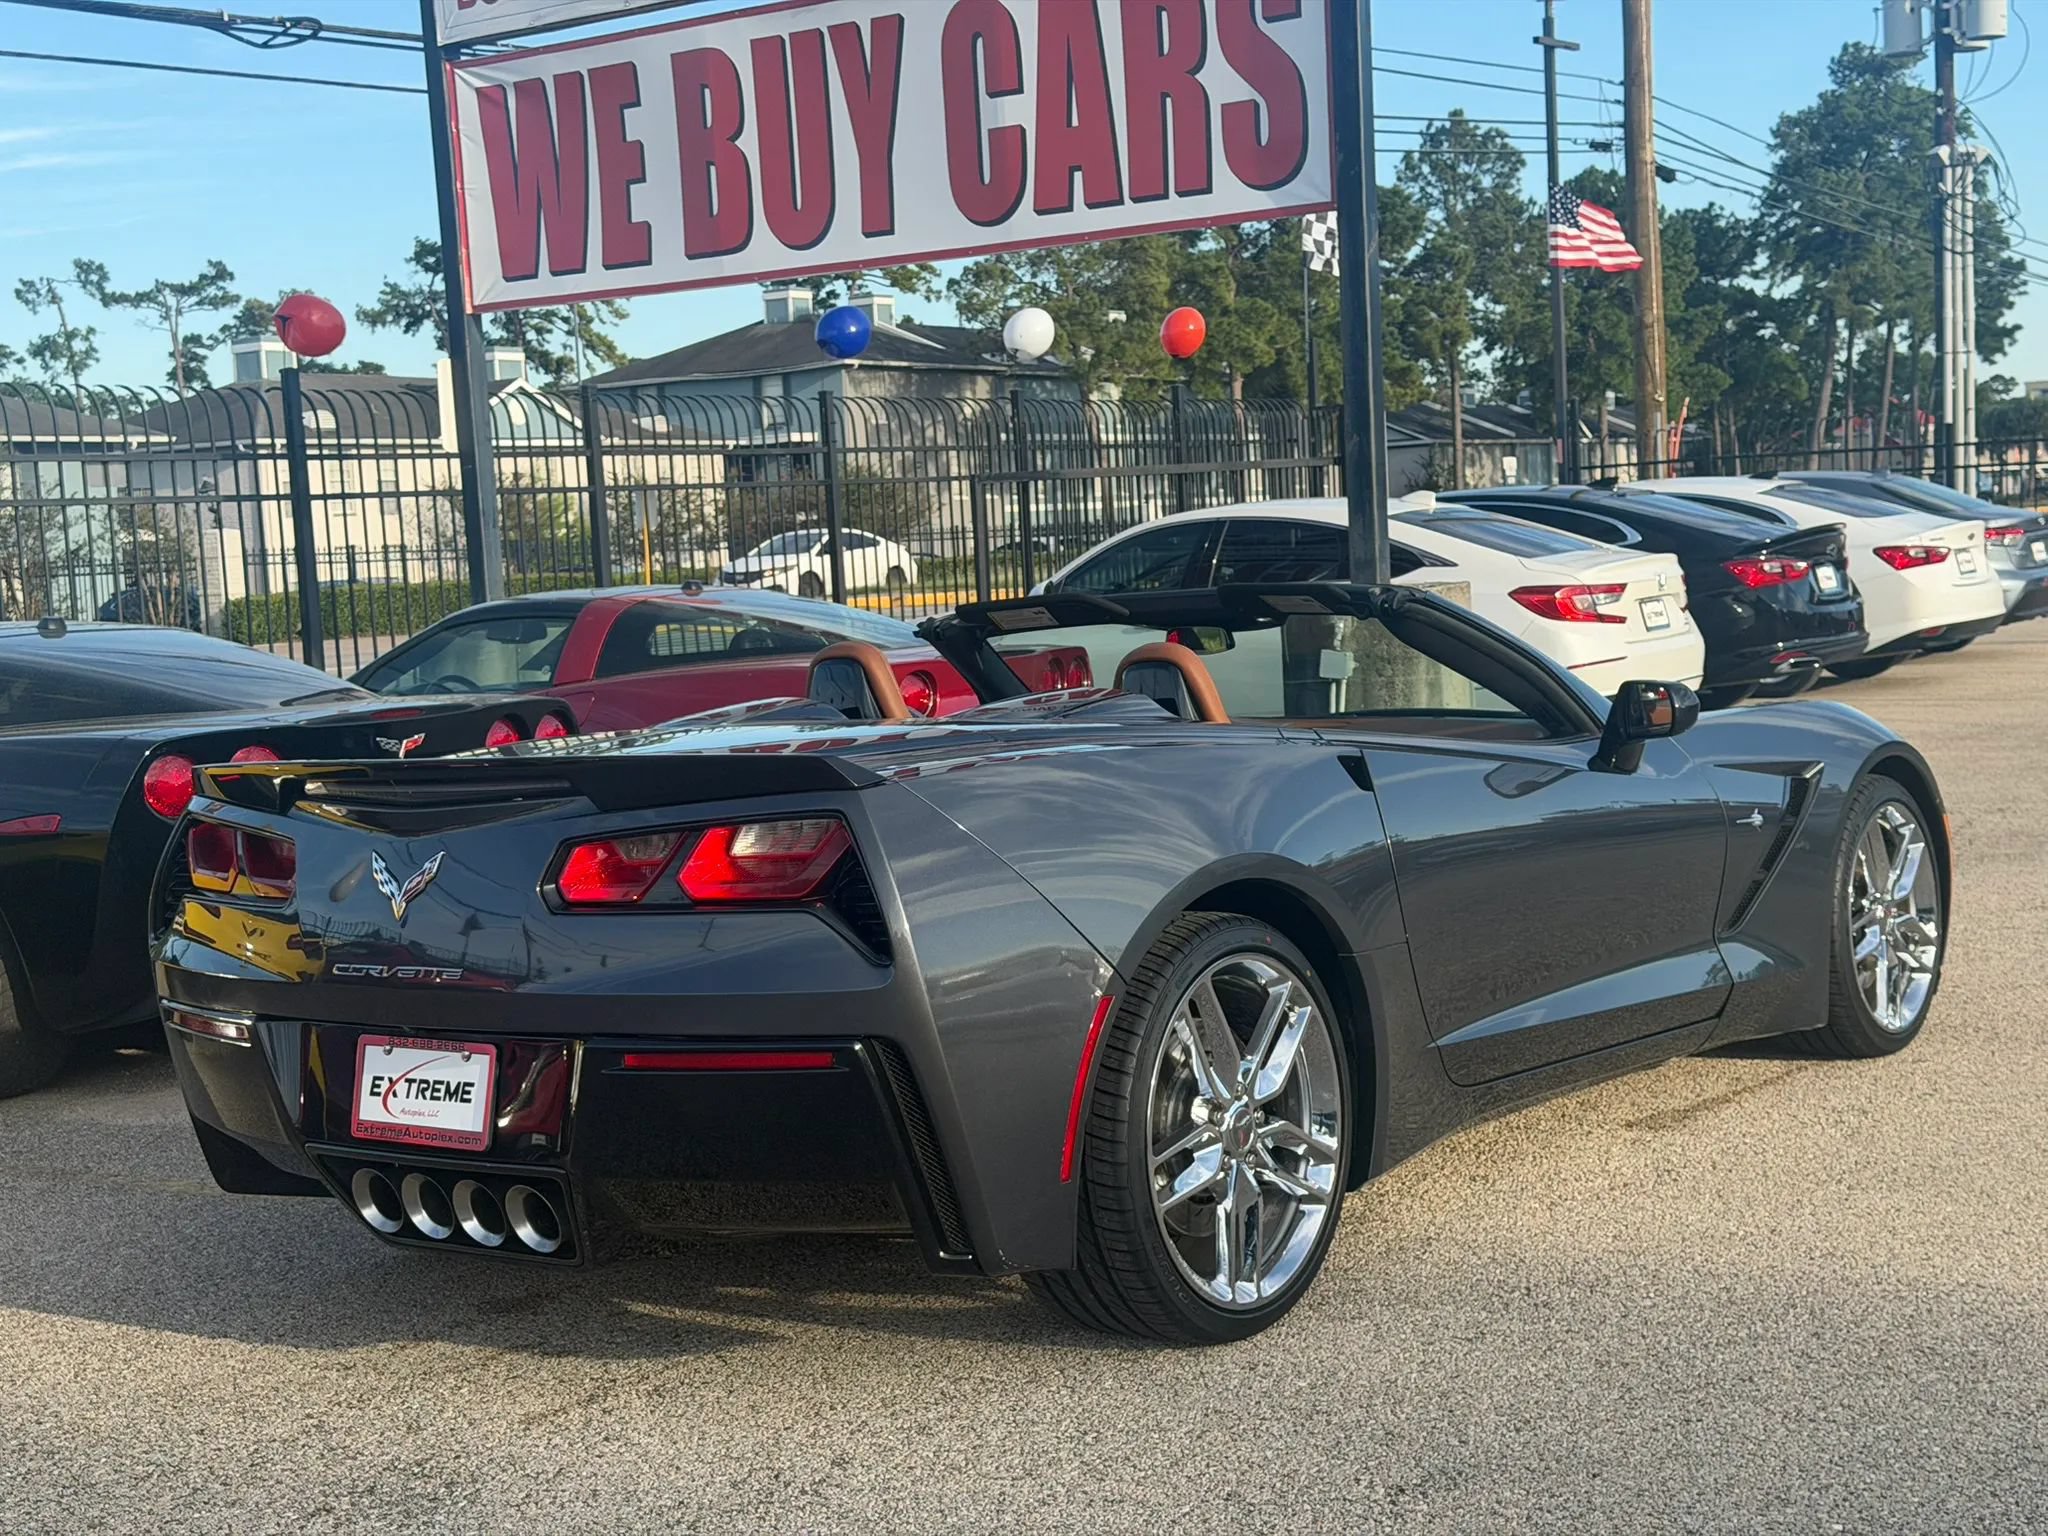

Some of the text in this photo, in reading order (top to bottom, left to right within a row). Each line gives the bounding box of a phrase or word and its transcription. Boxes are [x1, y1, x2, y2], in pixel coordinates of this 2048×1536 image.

[476, 0, 1308, 282] WE BUY CARS
[333, 963, 464, 980] CORVETTE
[369, 1075, 476, 1104] EXTREME
[355, 1122, 482, 1145] ExtremeAutoplex.com
